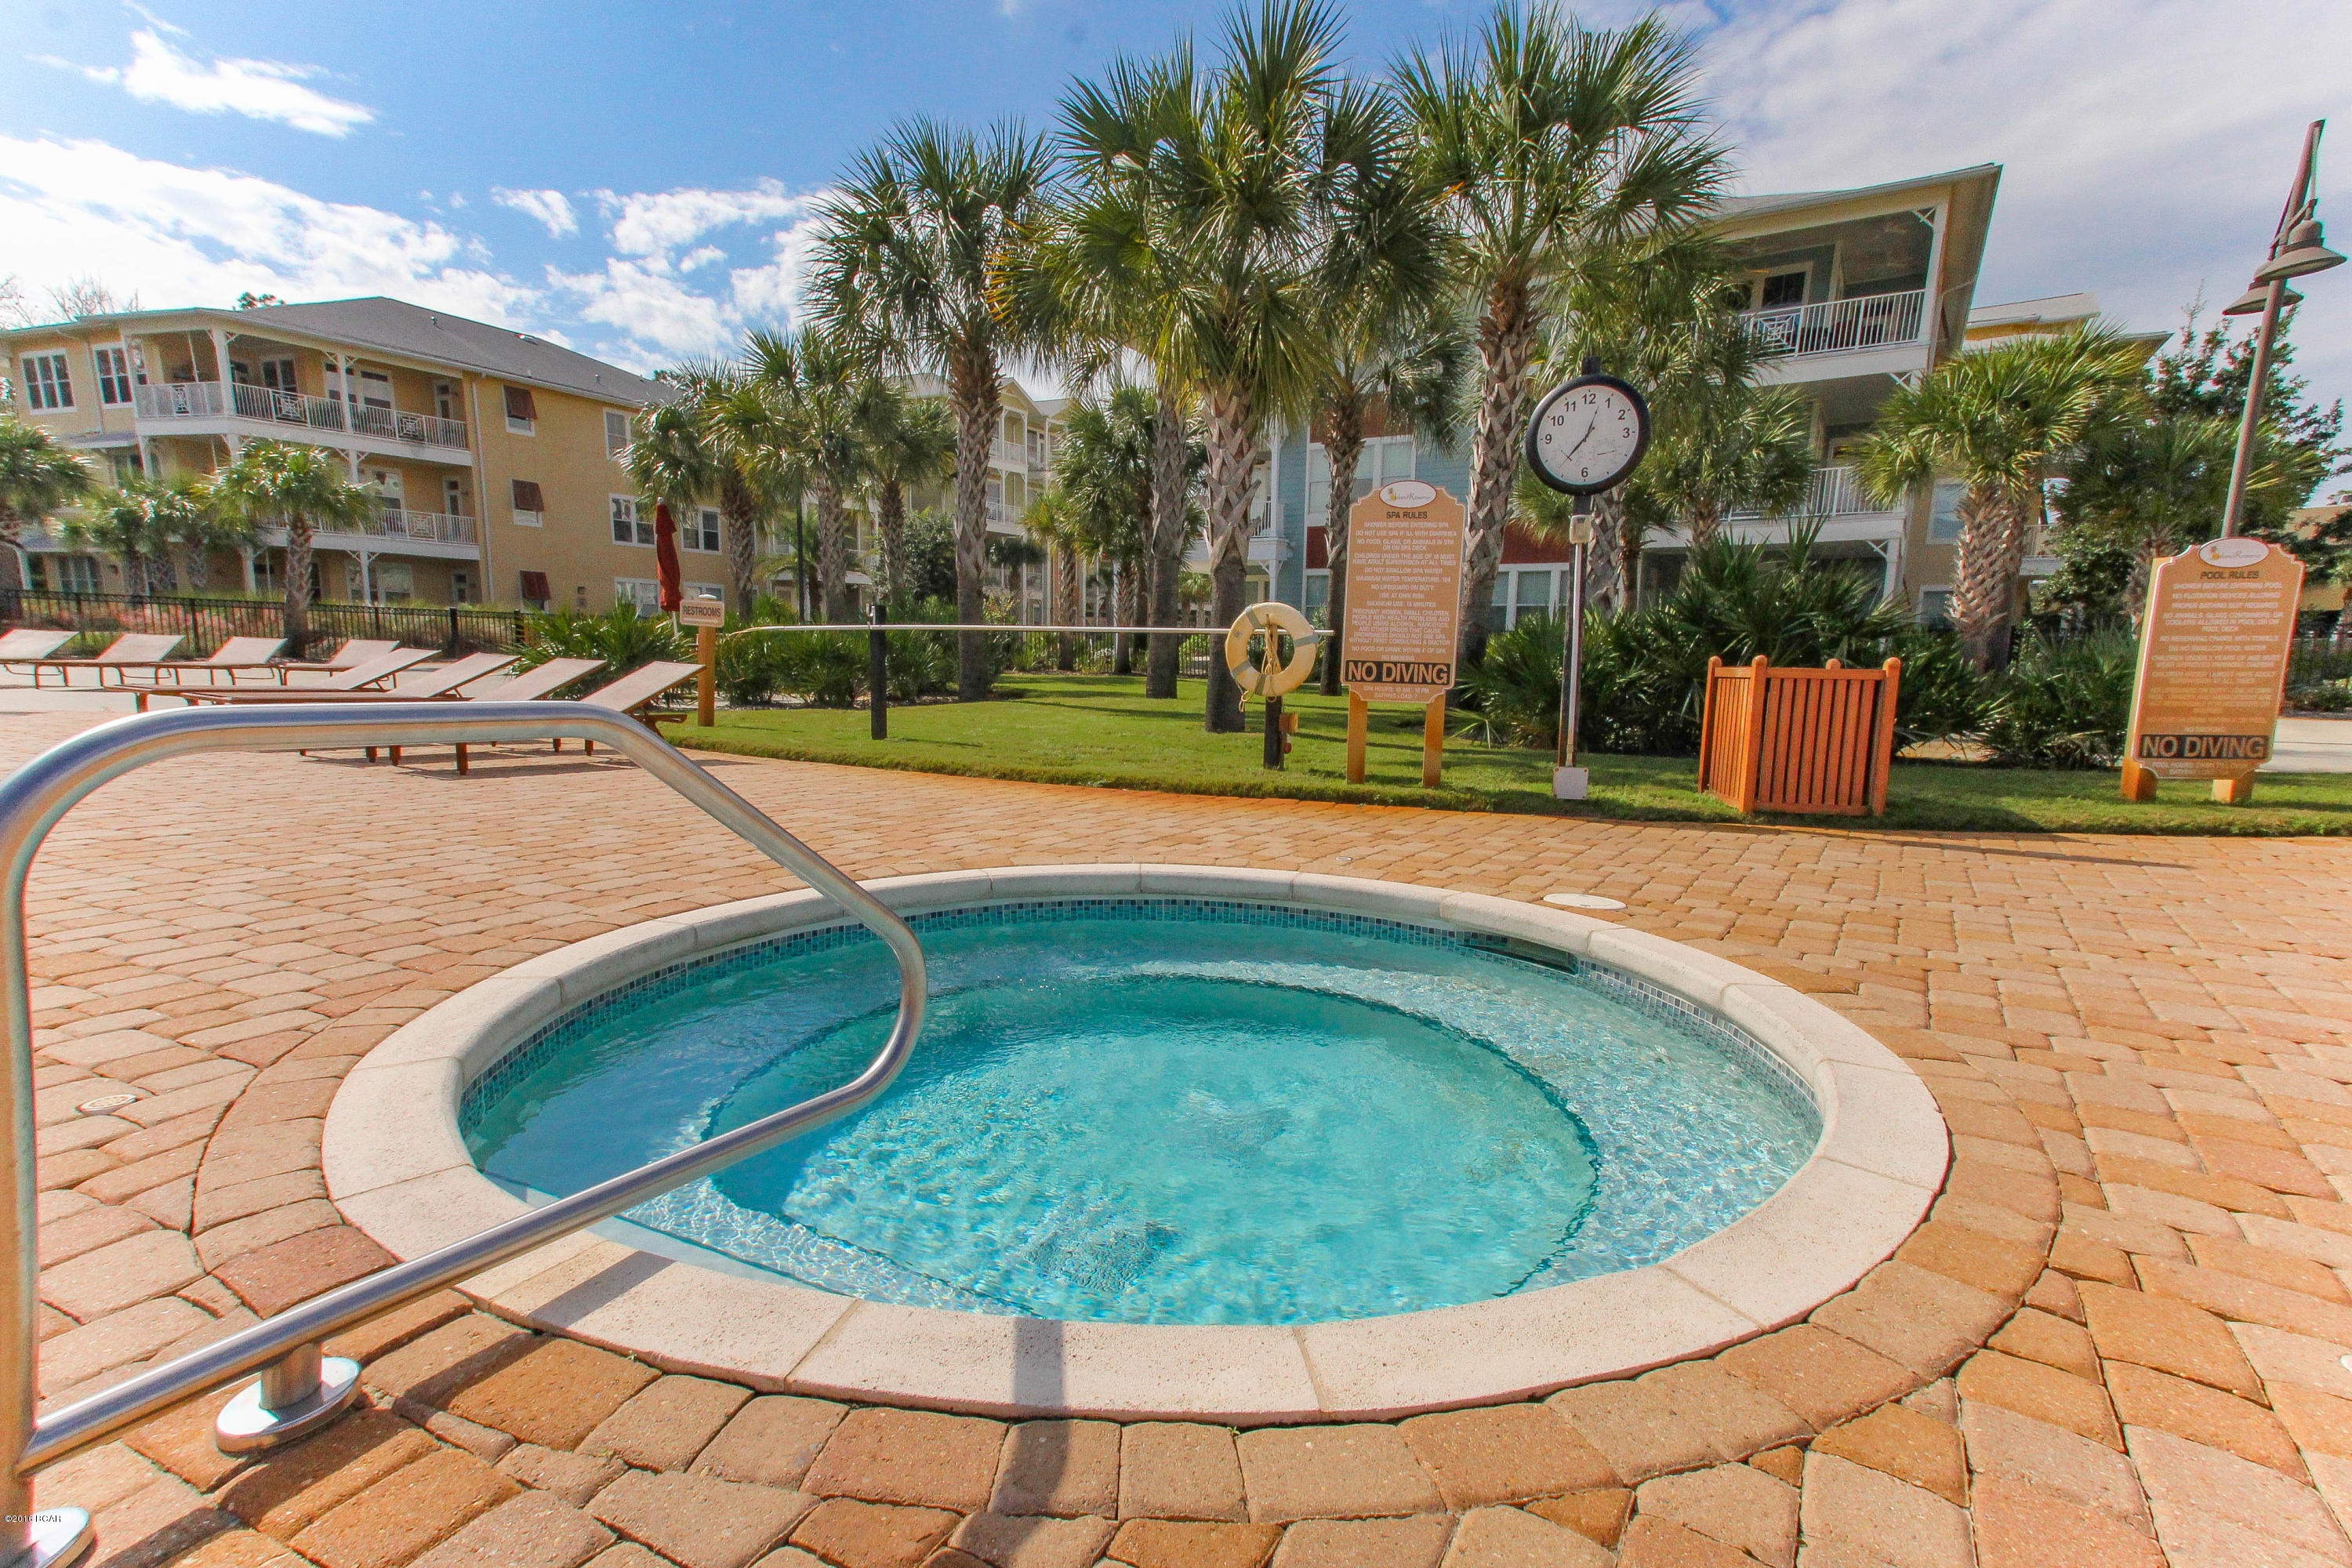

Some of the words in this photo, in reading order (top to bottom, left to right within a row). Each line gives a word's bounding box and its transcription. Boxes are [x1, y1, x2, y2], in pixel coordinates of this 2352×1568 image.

[1581, 393, 1596, 405] 12
[1605, 397, 1611, 408] 1
[1564, 401, 1577, 412] 11
[1617, 409, 1626, 420] 2
[1550, 415, 1565, 426] 10
[1622, 427, 1630, 438] 3
[1544, 434, 1552, 445] 9
[1581, 467, 1588, 477] 6
[2200, 571, 2226, 579] POOL
[2228, 571, 2259, 579] RULES
[683, 605, 721, 618] RESTROOMS
[1348, 662, 1377, 681] NO
[1382, 662, 1449, 684] DIVING
[2143, 736, 2179, 757] NO
[2183, 737, 2265, 758] DIVING
